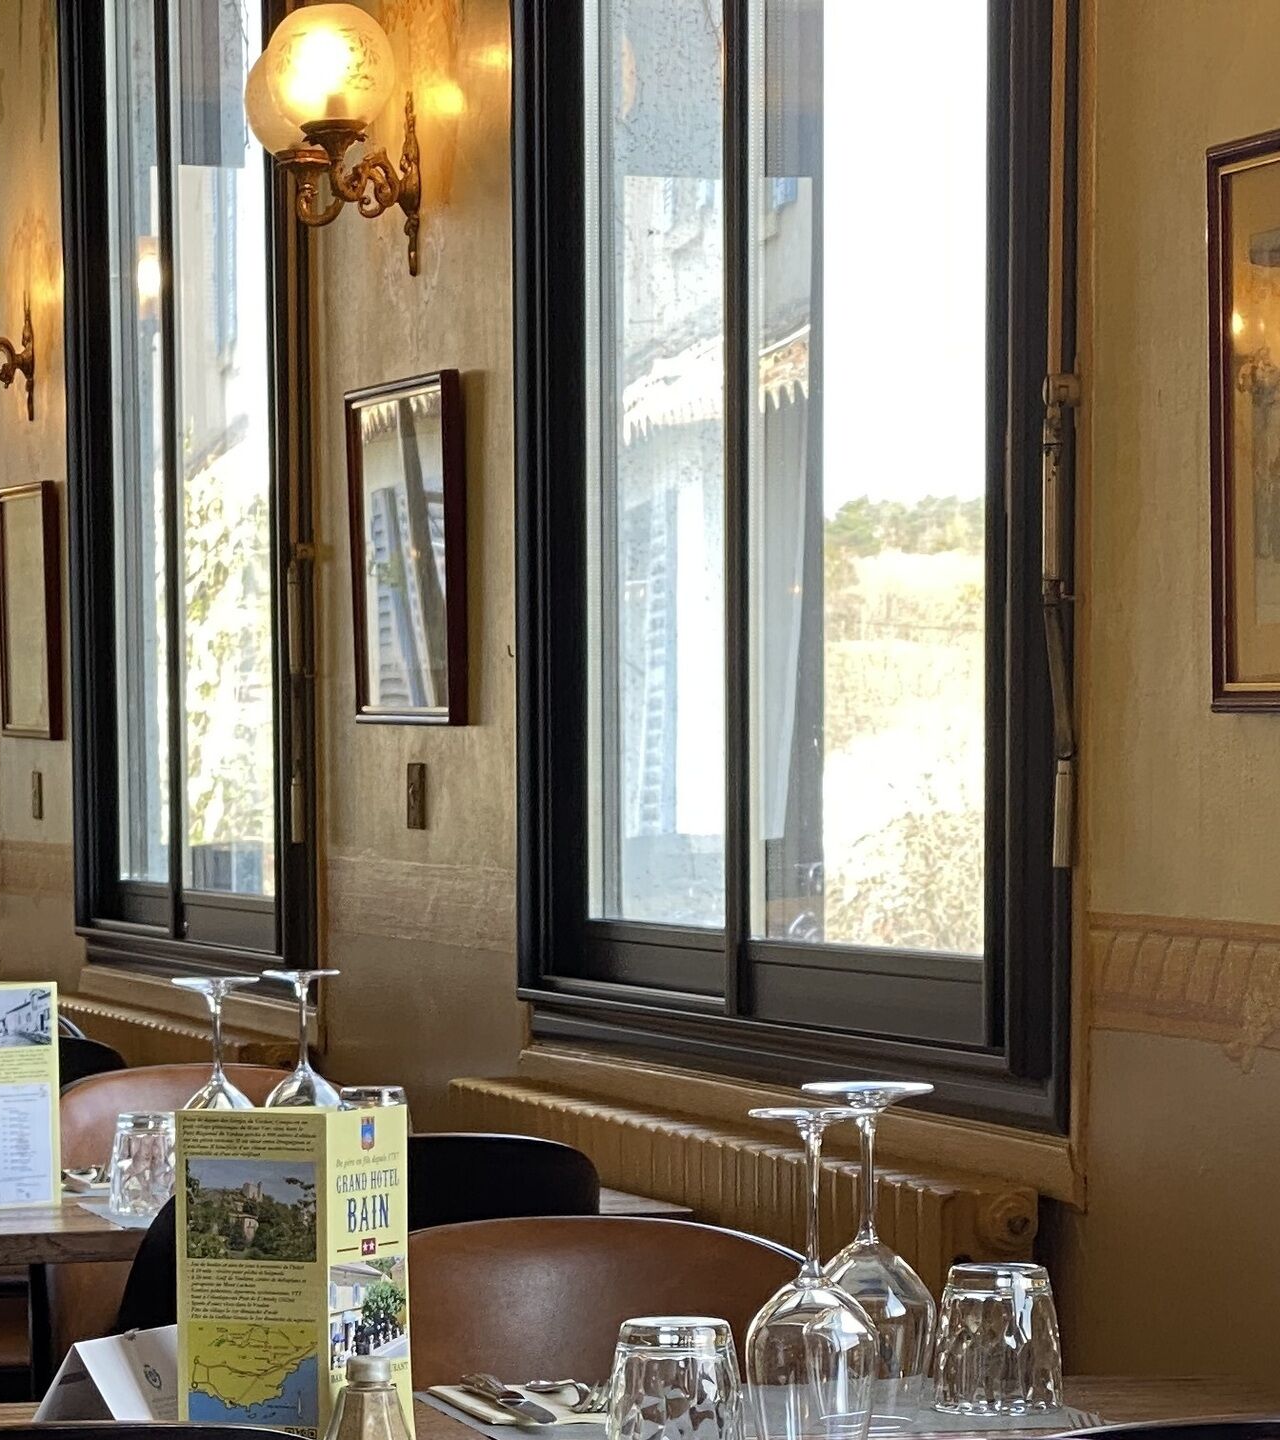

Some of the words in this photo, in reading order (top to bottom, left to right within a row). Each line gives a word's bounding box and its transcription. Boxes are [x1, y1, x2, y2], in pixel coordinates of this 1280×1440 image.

[336, 1172, 368, 1194] GRAND
[370, 1168, 400, 1190] HOTEL
[346, 1193, 390, 1234] BAIN
